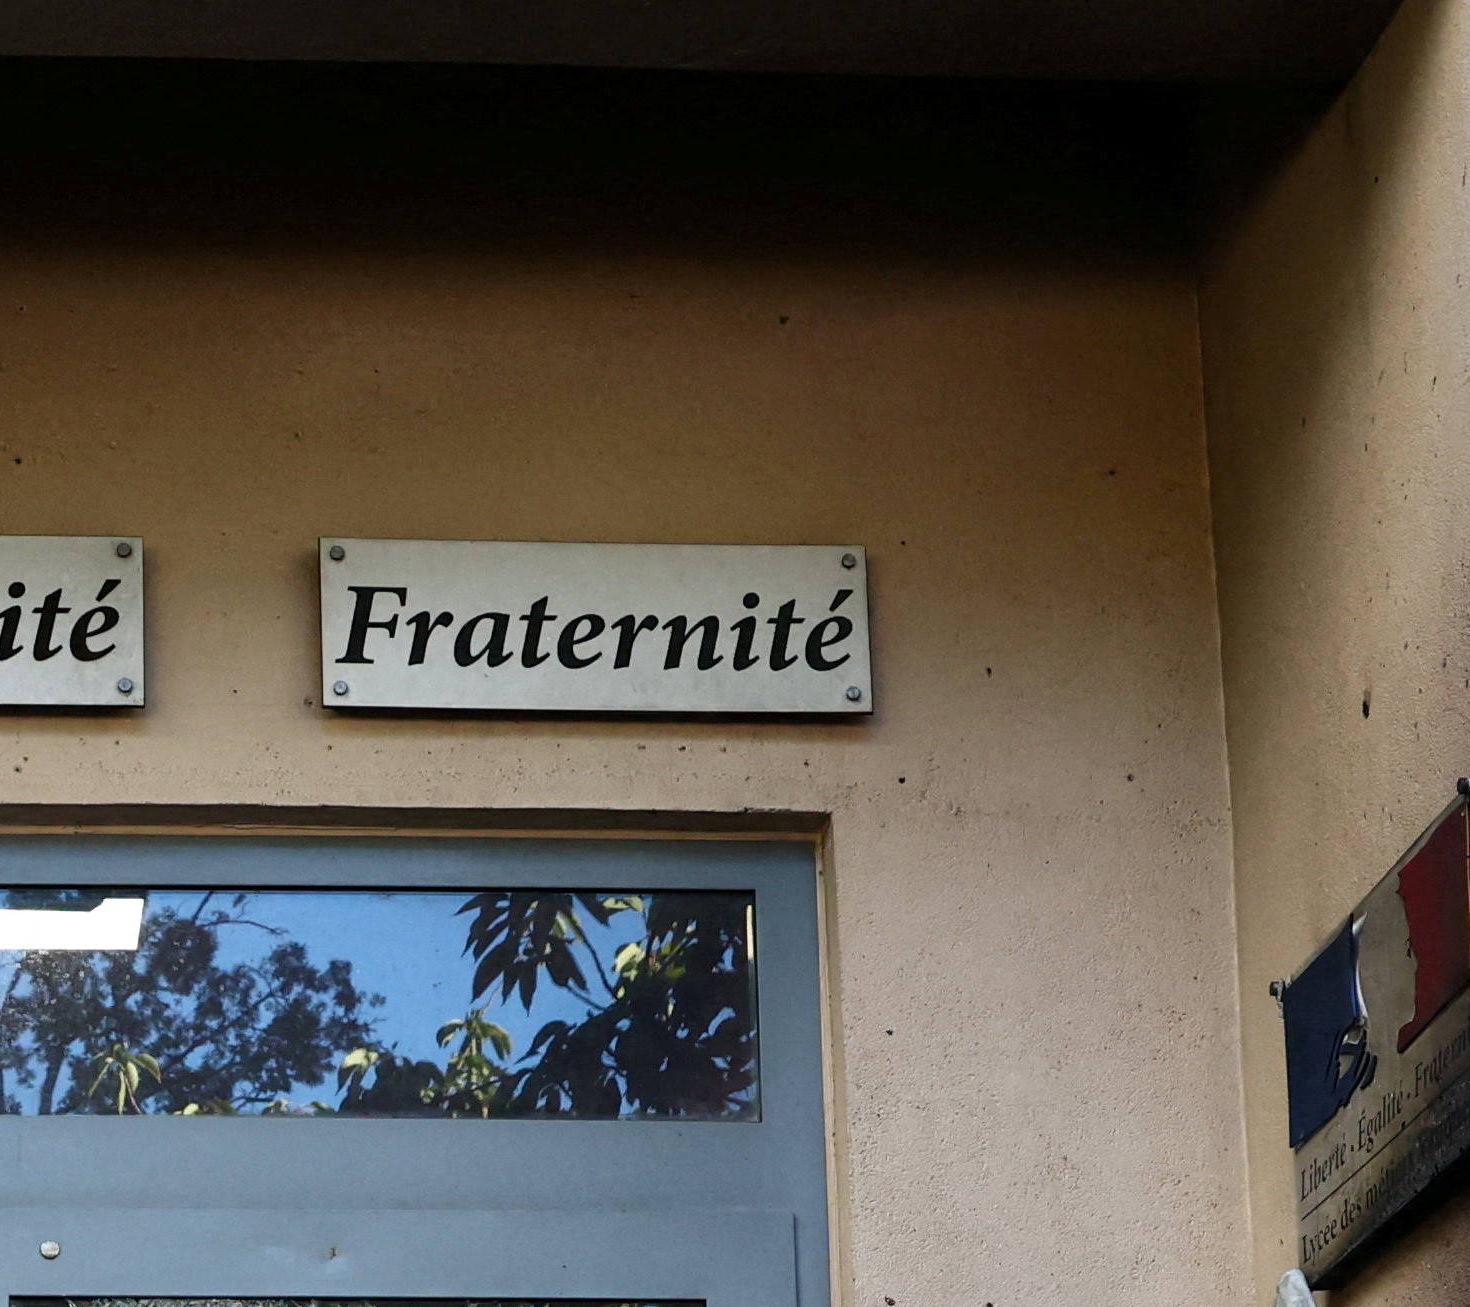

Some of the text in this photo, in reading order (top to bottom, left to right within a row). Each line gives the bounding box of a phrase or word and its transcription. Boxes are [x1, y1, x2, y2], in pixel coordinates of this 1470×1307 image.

[334, 586, 854, 672] Fraternité
[1301, 1134, 1346, 1201] Liberté
[1358, 1080, 1403, 1152] Égalité
[1303, 1214, 1337, 1265] Lycée
[1341, 1198, 1361, 1235] des
